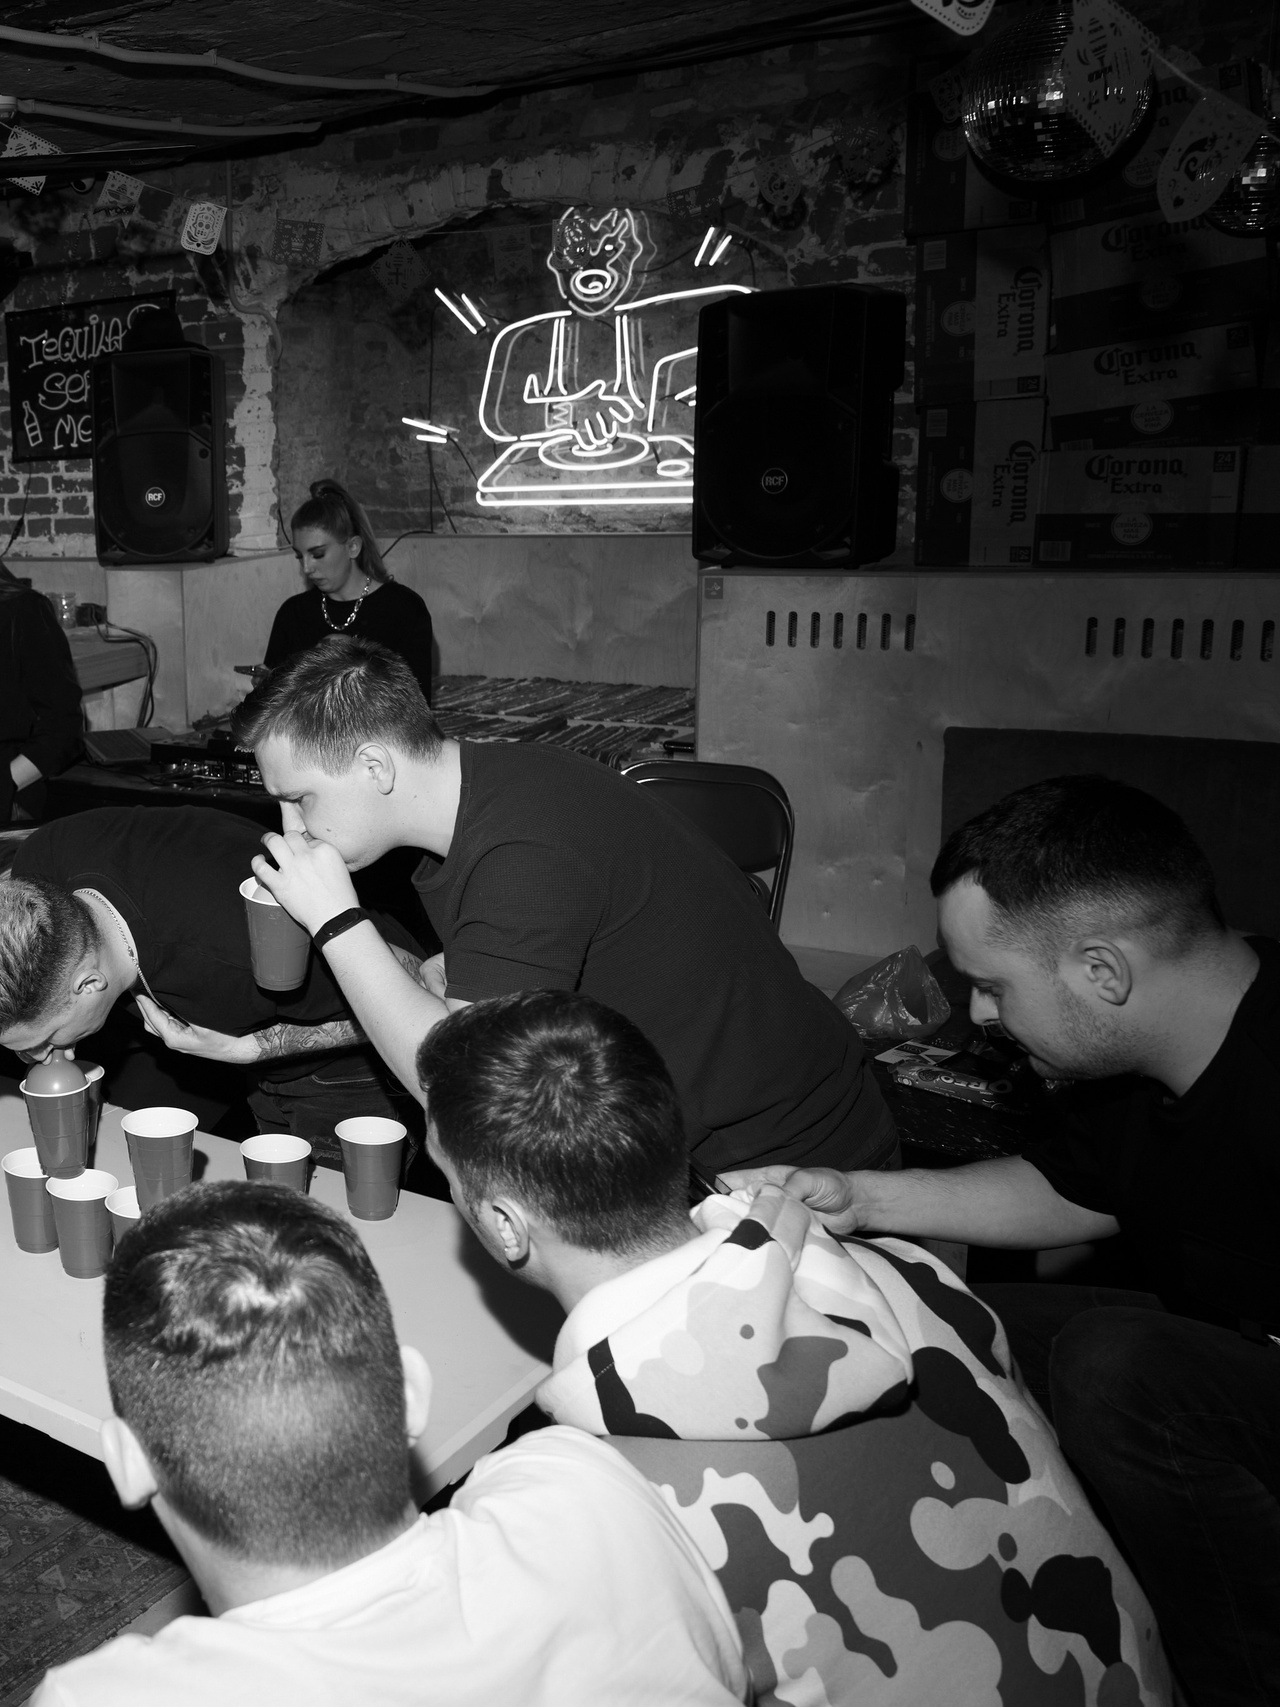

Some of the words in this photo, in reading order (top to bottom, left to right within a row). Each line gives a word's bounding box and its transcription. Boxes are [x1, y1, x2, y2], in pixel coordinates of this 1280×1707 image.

[1131, 242, 1186, 262] Extra
[997, 292, 1017, 339] Extra
[1011, 266, 1043, 354] Corona
[1094, 340, 1196, 376] Corona
[1123, 368, 1178, 386] Extra
[1085, 453, 1184, 483] Corona
[1217, 453, 1232, 464] 24
[765, 475, 784, 486] RCF
[992, 464, 1011, 508] Extra
[1005, 441, 1038, 524] Corona
[1110, 478, 1163, 494] Extra
[148, 492, 163, 502] RCF
